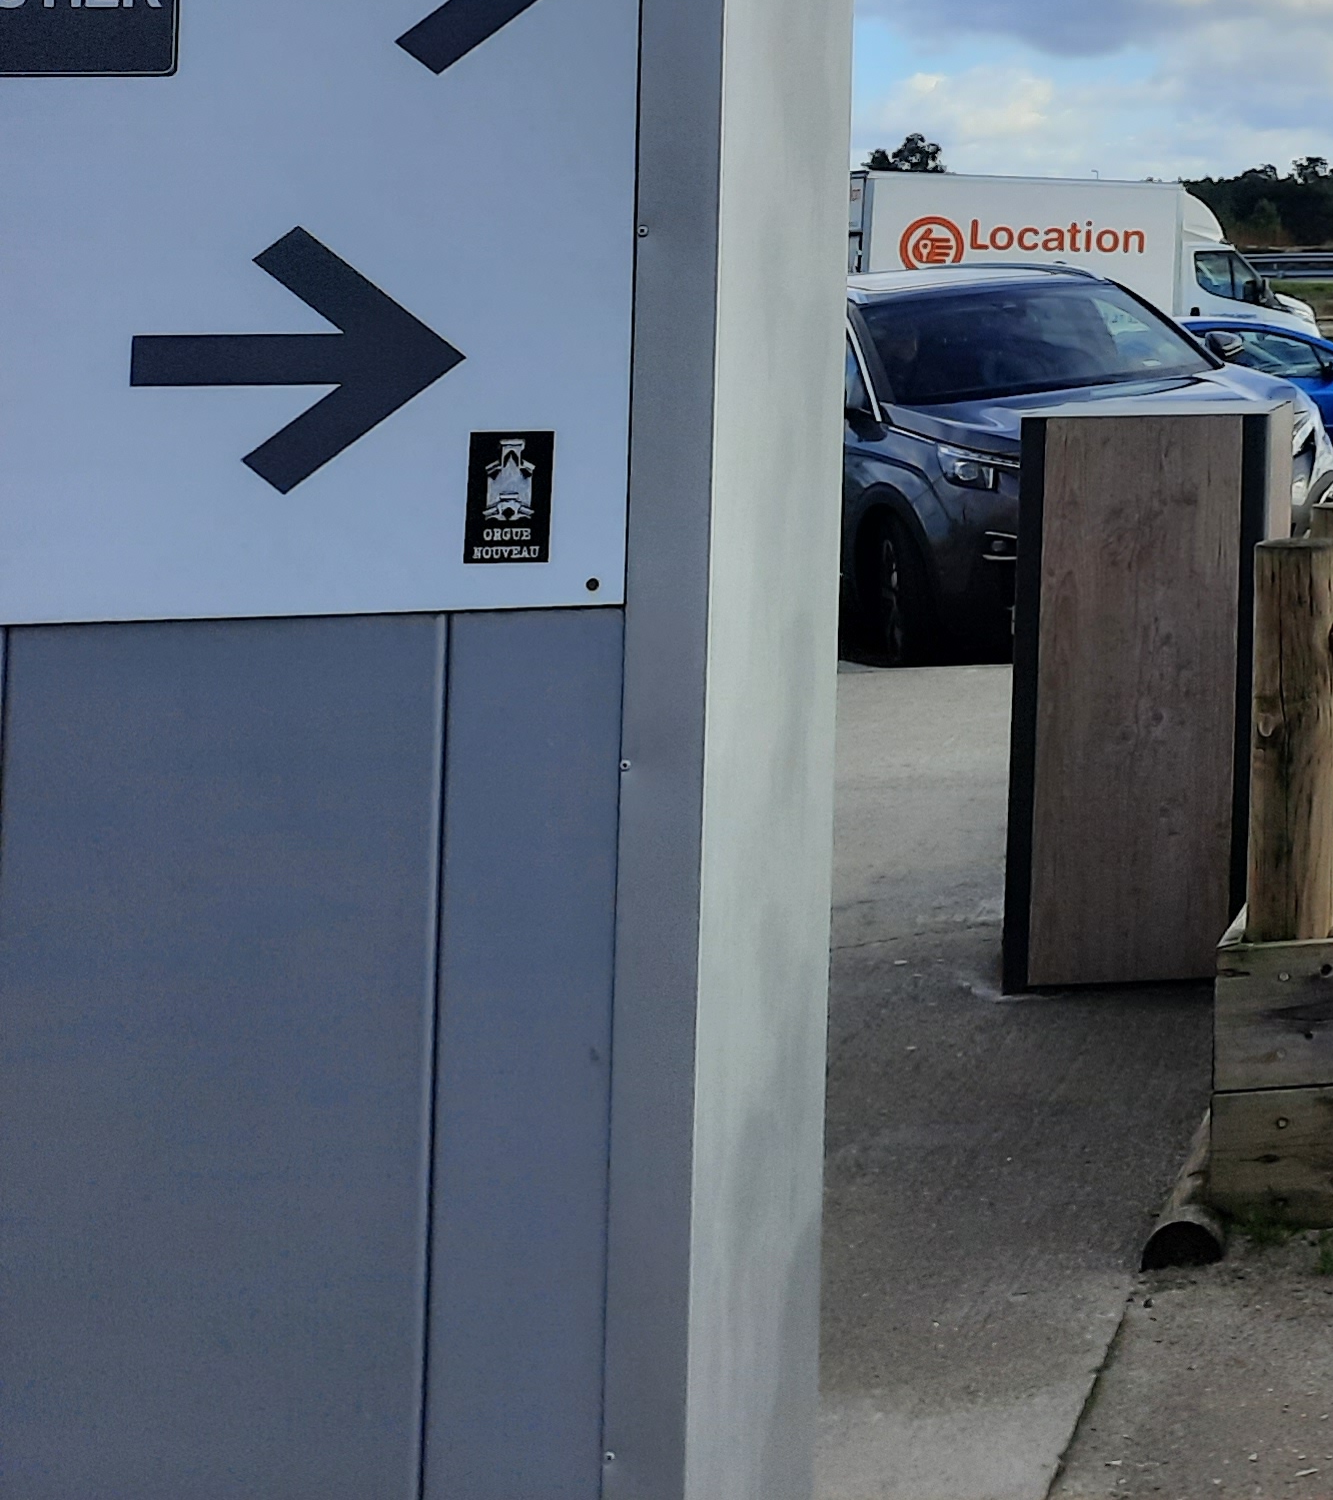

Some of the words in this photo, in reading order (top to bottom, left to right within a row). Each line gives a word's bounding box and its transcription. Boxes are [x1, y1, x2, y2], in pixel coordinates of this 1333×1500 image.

[968, 218, 1146, 255] Location
[483, 528, 531, 541] ORGUE
[472, 546, 540, 559] NOUVEAU
